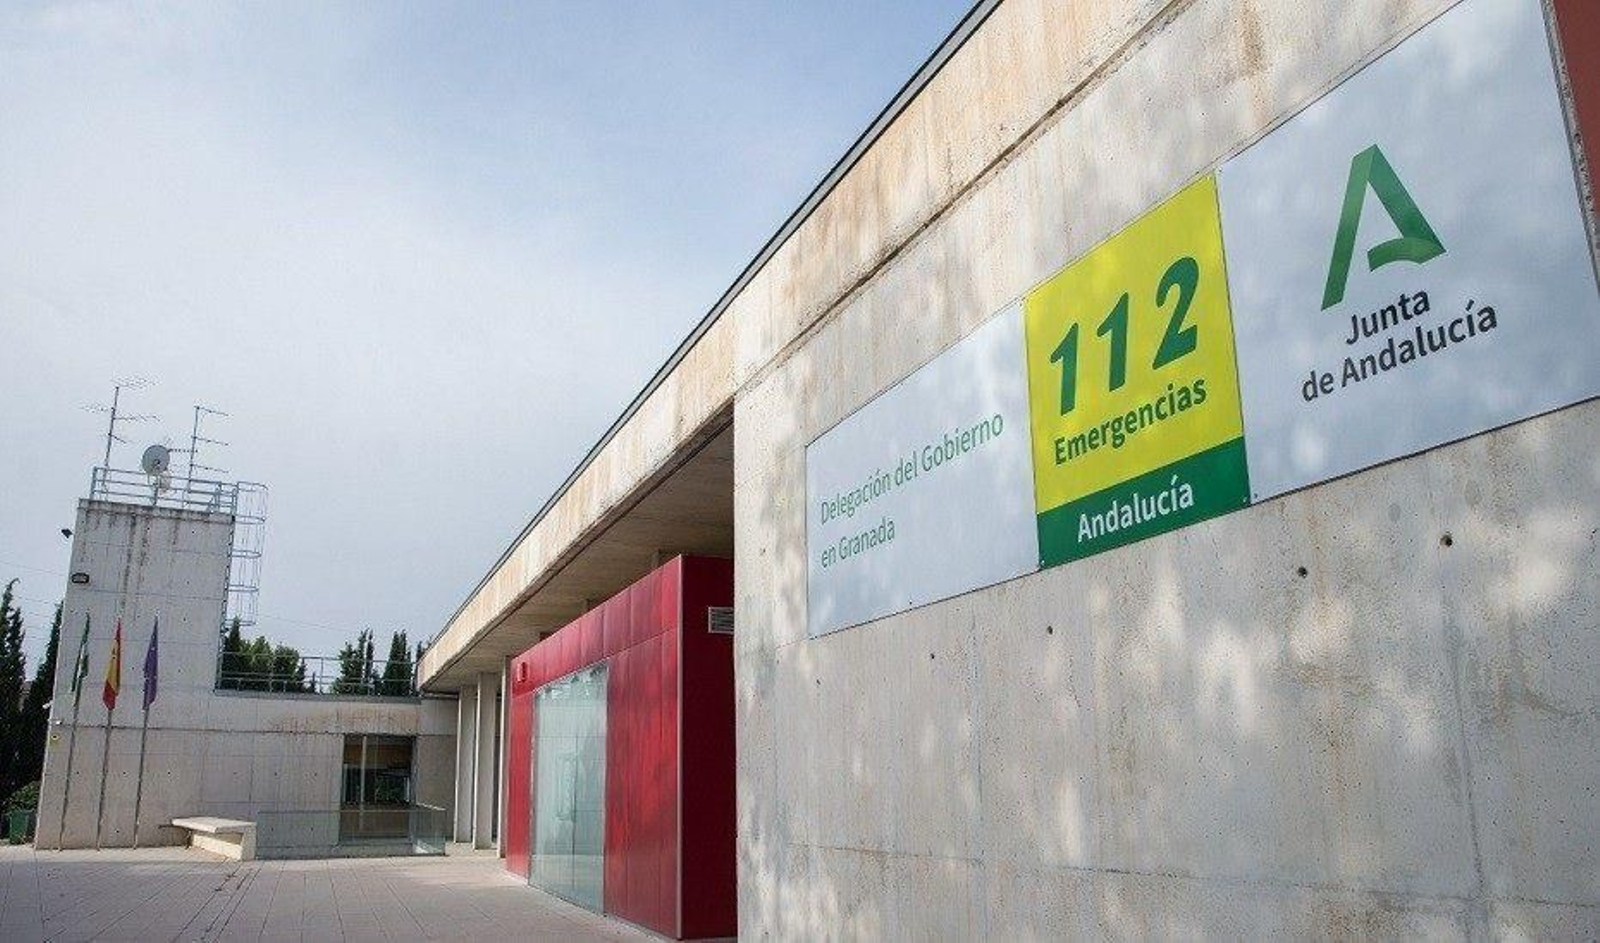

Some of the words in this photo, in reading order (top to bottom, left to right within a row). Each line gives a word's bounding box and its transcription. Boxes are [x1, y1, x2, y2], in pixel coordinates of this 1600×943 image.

[1050, 256, 1200, 416] 112
[1301, 370, 1335, 402] de
[1341, 299, 1498, 388] Andalucía
[1345, 289, 1430, 345] Junta
[1054, 377, 1207, 465] Emergencias
[820, 468, 891, 525] Delegación
[894, 451, 919, 486] del
[921, 413, 1004, 473] Gobierno
[1077, 473, 1194, 543] Andalucía
[820, 541, 837, 568] en
[838, 516, 896, 560] Granada
